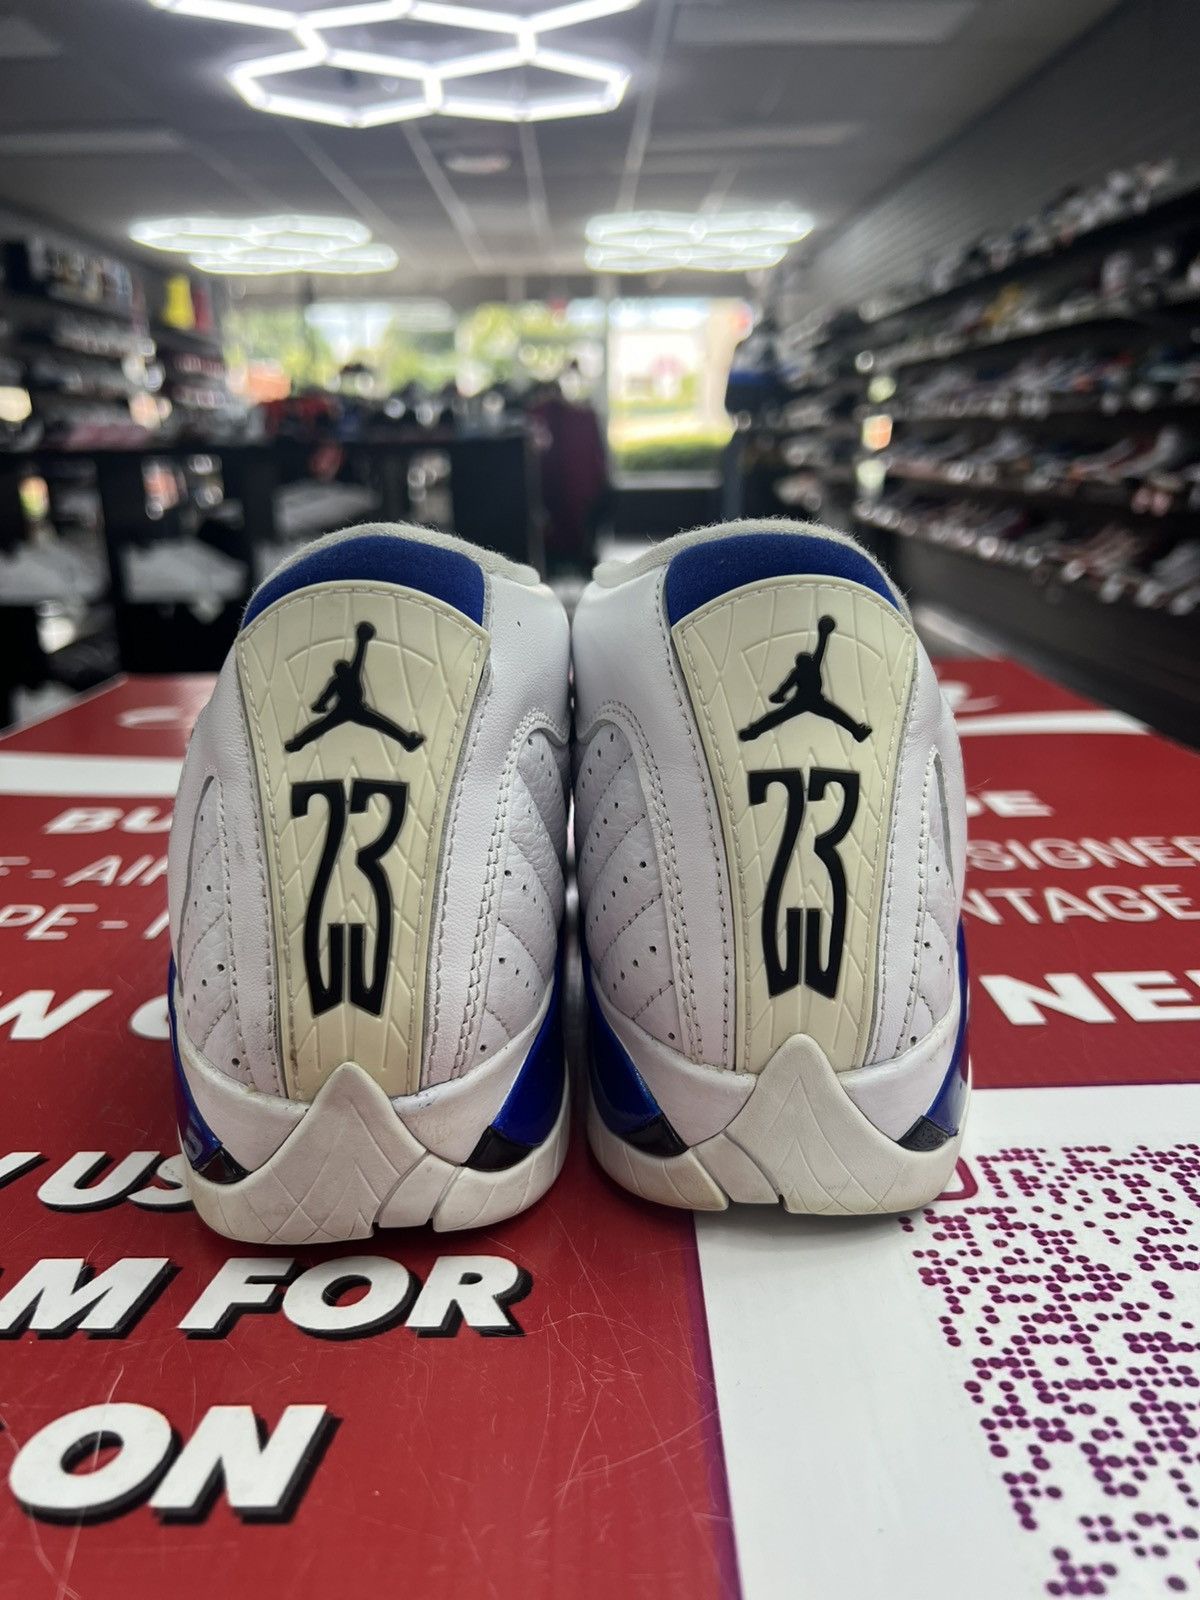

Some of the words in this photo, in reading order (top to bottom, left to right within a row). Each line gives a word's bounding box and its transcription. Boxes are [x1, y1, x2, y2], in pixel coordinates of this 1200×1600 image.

[290, 779, 411, 1018] 23
[748, 767, 861, 1000] 23
[966, 836, 1200, 871] SIGNE
[979, 969, 1200, 1025] NE
[178, 1256, 521, 1332] FOR
[9, 1402, 328, 1511] ON
